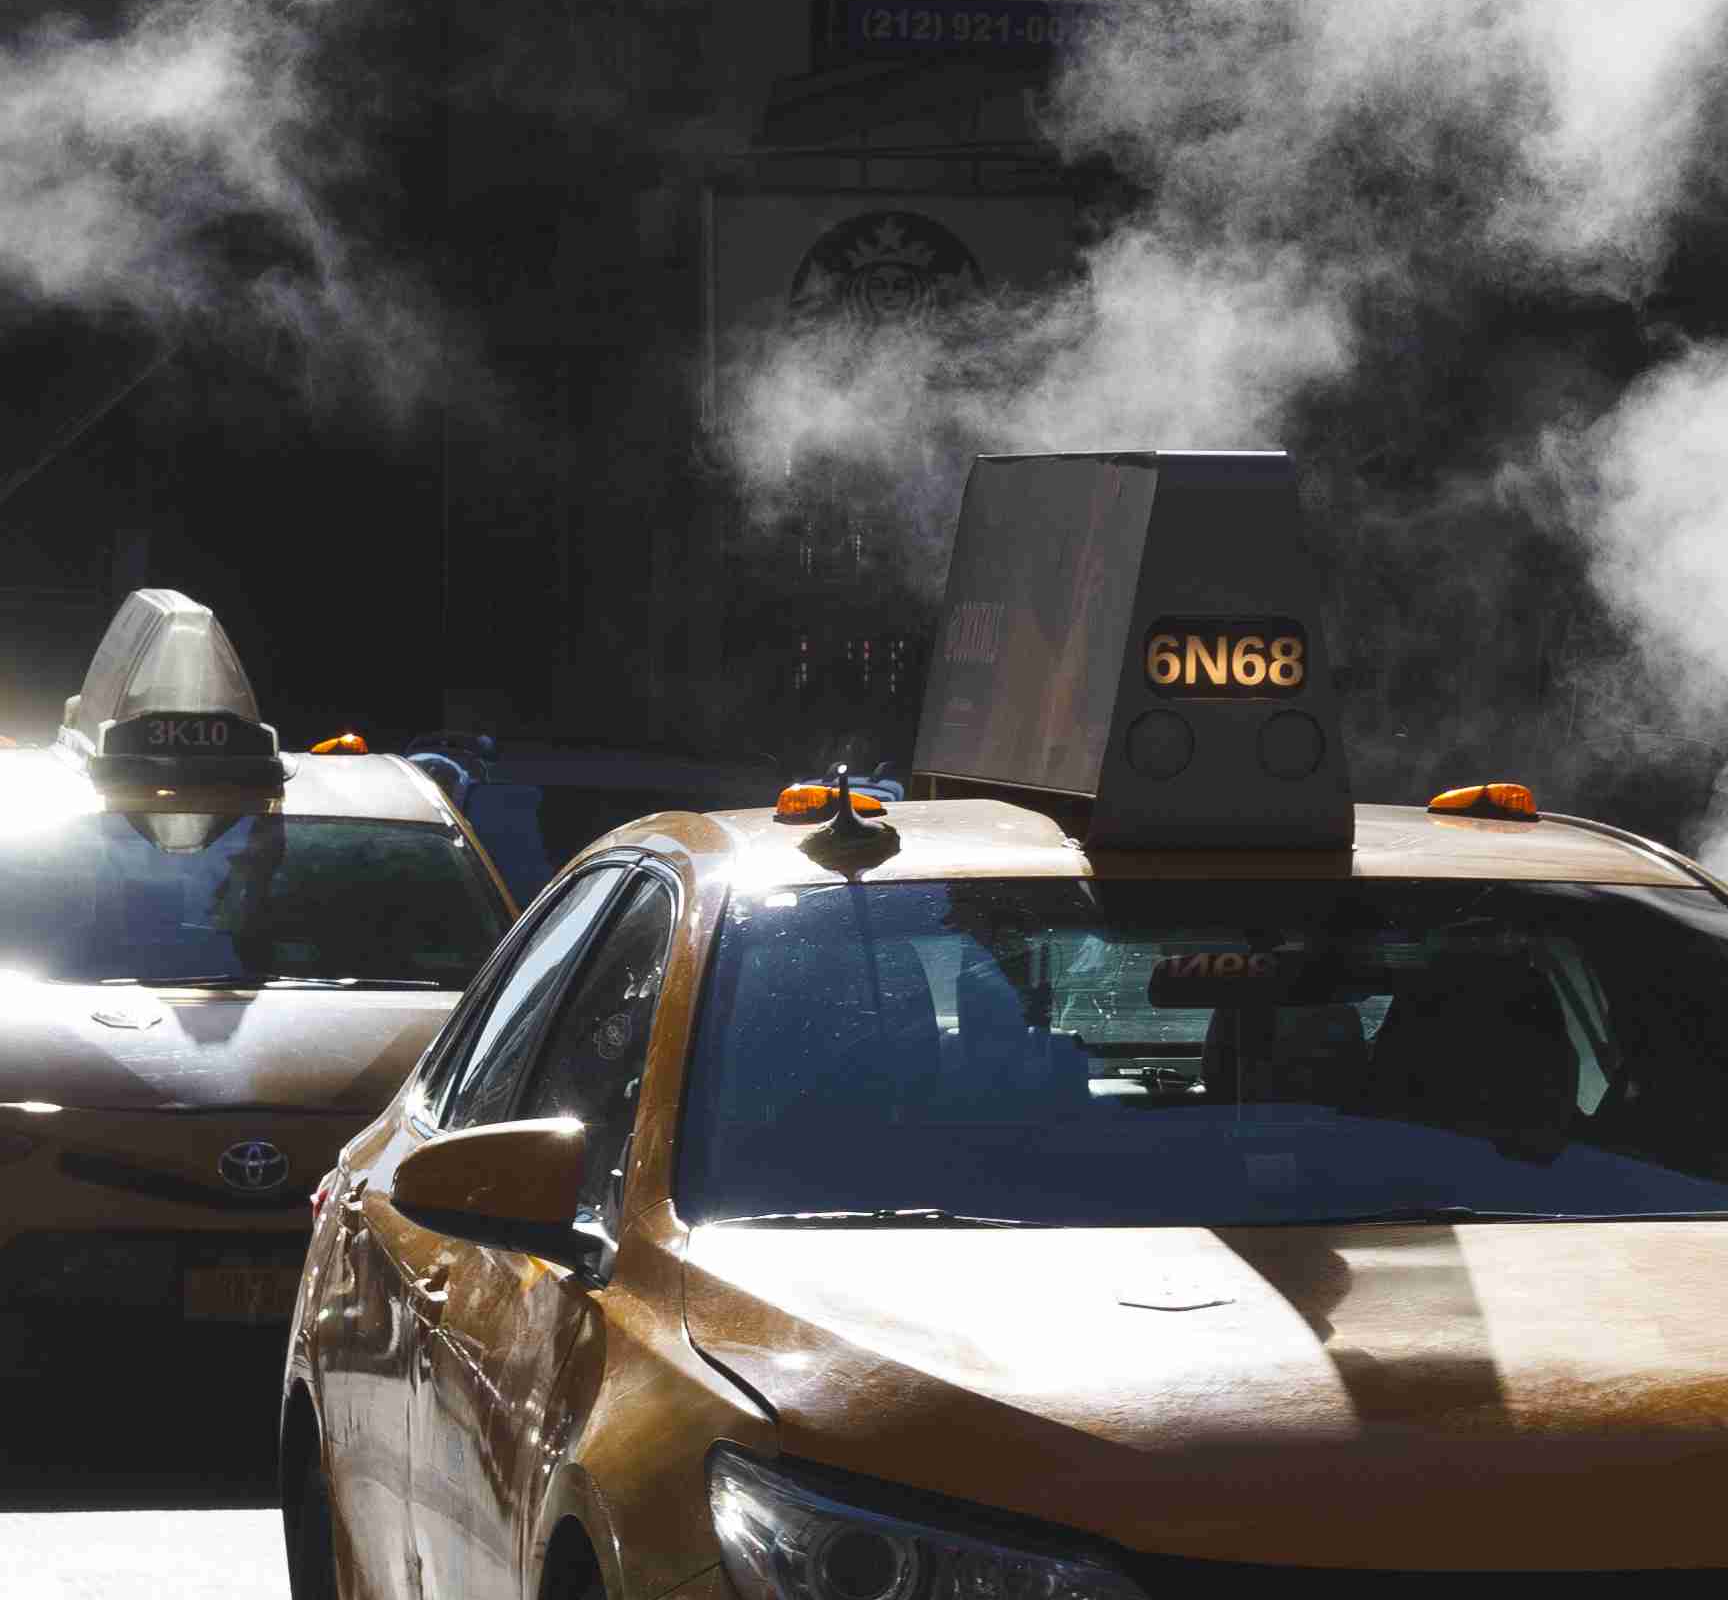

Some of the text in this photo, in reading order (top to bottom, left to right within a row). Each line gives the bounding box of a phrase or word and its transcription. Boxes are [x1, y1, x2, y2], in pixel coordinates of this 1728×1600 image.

[862, 8, 943, 42] (212)
[1147, 633, 1304, 688] 6N68
[147, 720, 228, 746] 3K10
